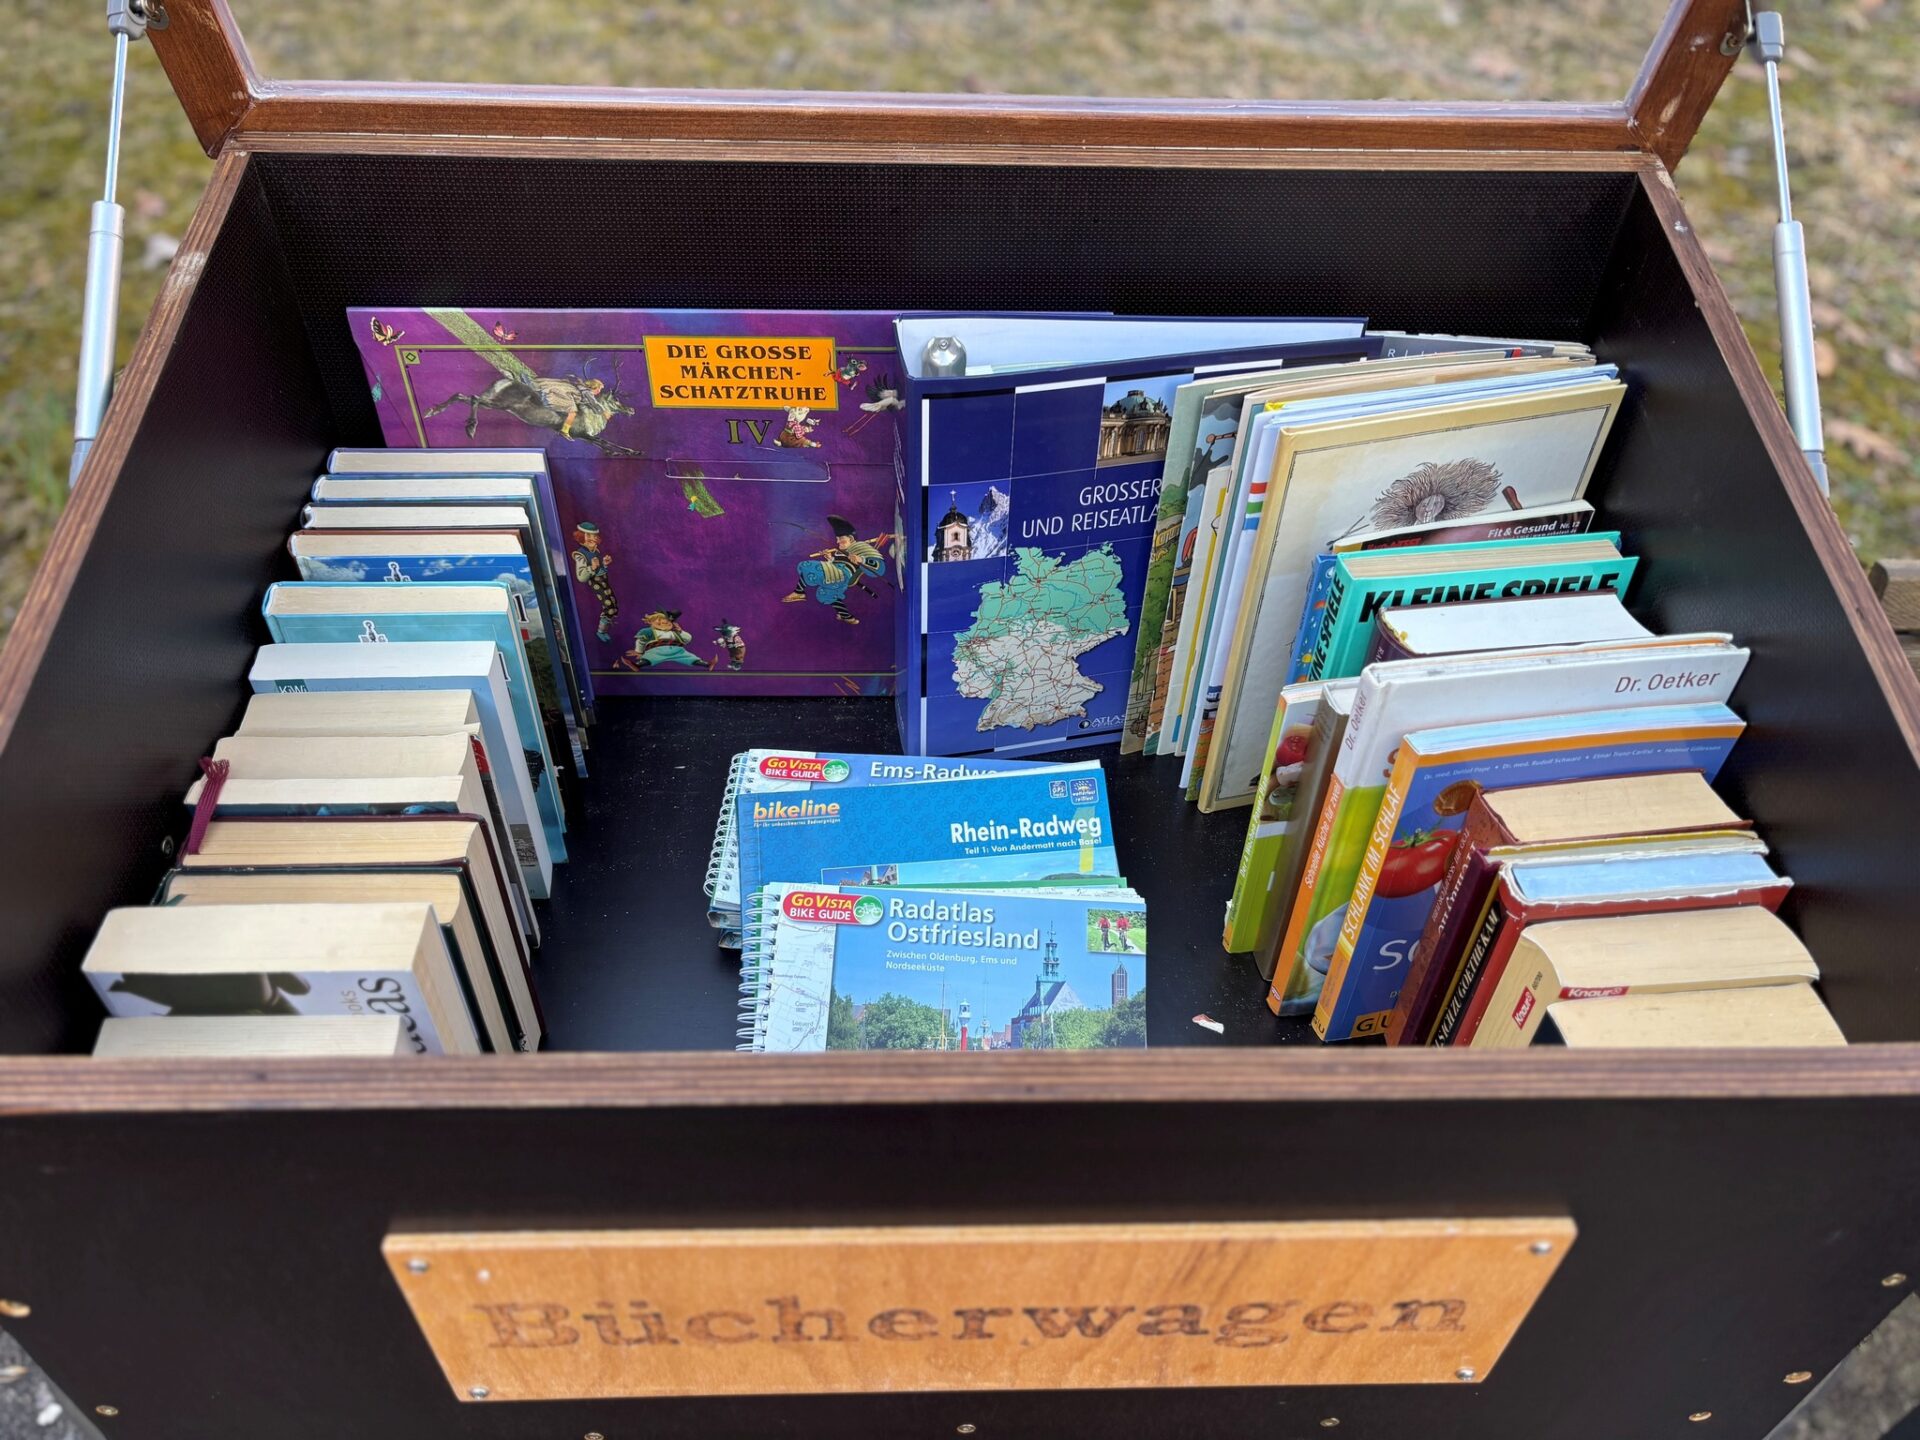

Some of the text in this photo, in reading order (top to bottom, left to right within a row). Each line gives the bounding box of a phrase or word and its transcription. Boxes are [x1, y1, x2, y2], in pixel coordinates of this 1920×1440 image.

[666, 344, 812, 360] DIE GROSSE
[680, 362, 802, 380] MÄRCHEN-
[660, 385, 827, 401] SCHATZTRUHE
[725, 419, 773, 445] IV
[1079, 478, 1162, 506] GROSSER
[1022, 504, 1160, 539] UND REISEATLA
[1513, 520, 1557, 535] Gesund
[1320, 577, 1345, 649] SPIELE
[1615, 672, 1720, 693] Dr. Oetker
[1091, 714, 1126, 724] ATLA
[1345, 692, 1368, 751] Dr. Oetker
[765, 768, 821, 779] BIKE GUIDE
[753, 799, 840, 820] bikeline
[951, 815, 1101, 844] Rhein-Radweg
[964, 837, 1102, 855] Teil 1: Von Andermatt nach Basel
[1304, 849, 1322, 889] Schnelle
[1343, 871, 1374, 940] SCHLANK
[1363, 844, 1382, 873] IM
[1373, 782, 1402, 844] SCHLAF
[789, 907, 852, 921] BIKE GUIDE
[889, 898, 995, 923] Radatlas
[887, 921, 1040, 949] Ostfriesland
[885, 961, 945, 972] Nordseeküste
[886, 950, 1018, 966] Zwischen Oldenburg, Ems und
[473, 1295, 1467, 1348] Bücherwagen
